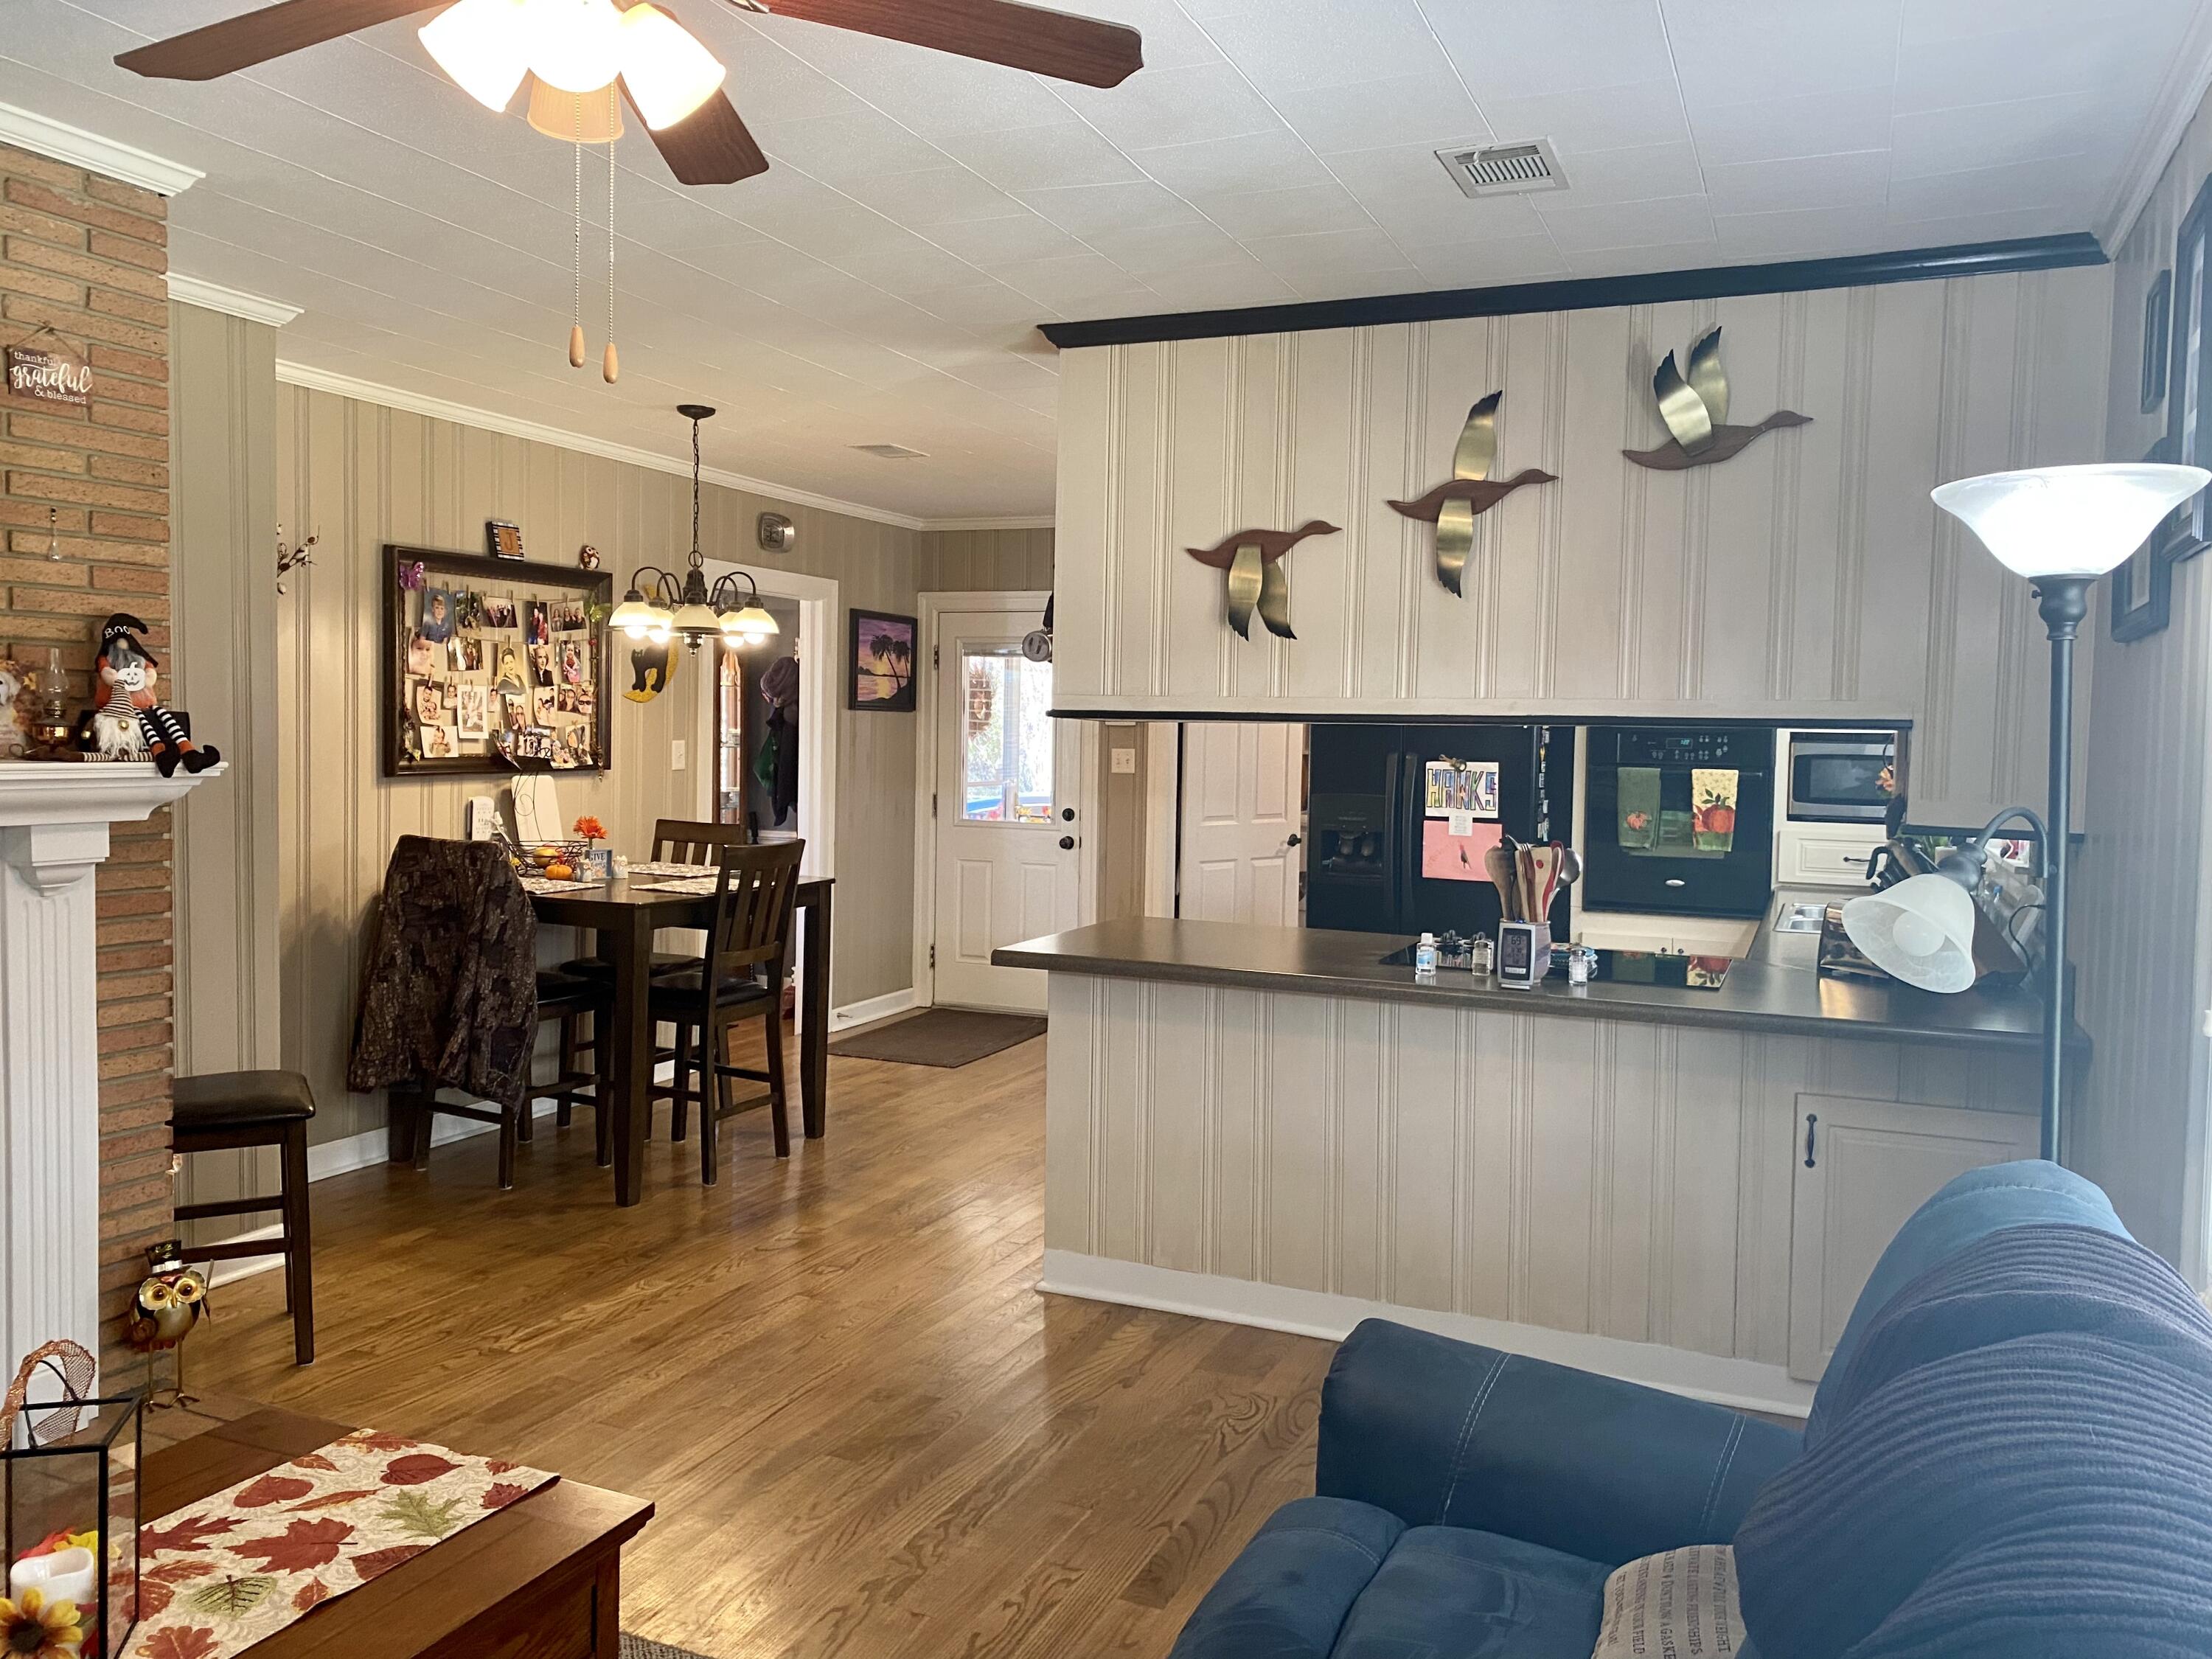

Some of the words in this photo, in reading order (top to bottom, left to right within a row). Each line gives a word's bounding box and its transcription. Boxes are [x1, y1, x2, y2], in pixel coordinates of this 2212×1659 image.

[10, 363, 94, 393] grateful
[34, 384, 44, 397] &
[46, 389, 87, 405] blessed
[1426, 768, 1498, 811] HAWKS
[1511, 936, 1521, 945] 69
[1660, 1628, 1677, 1659] GASKE
